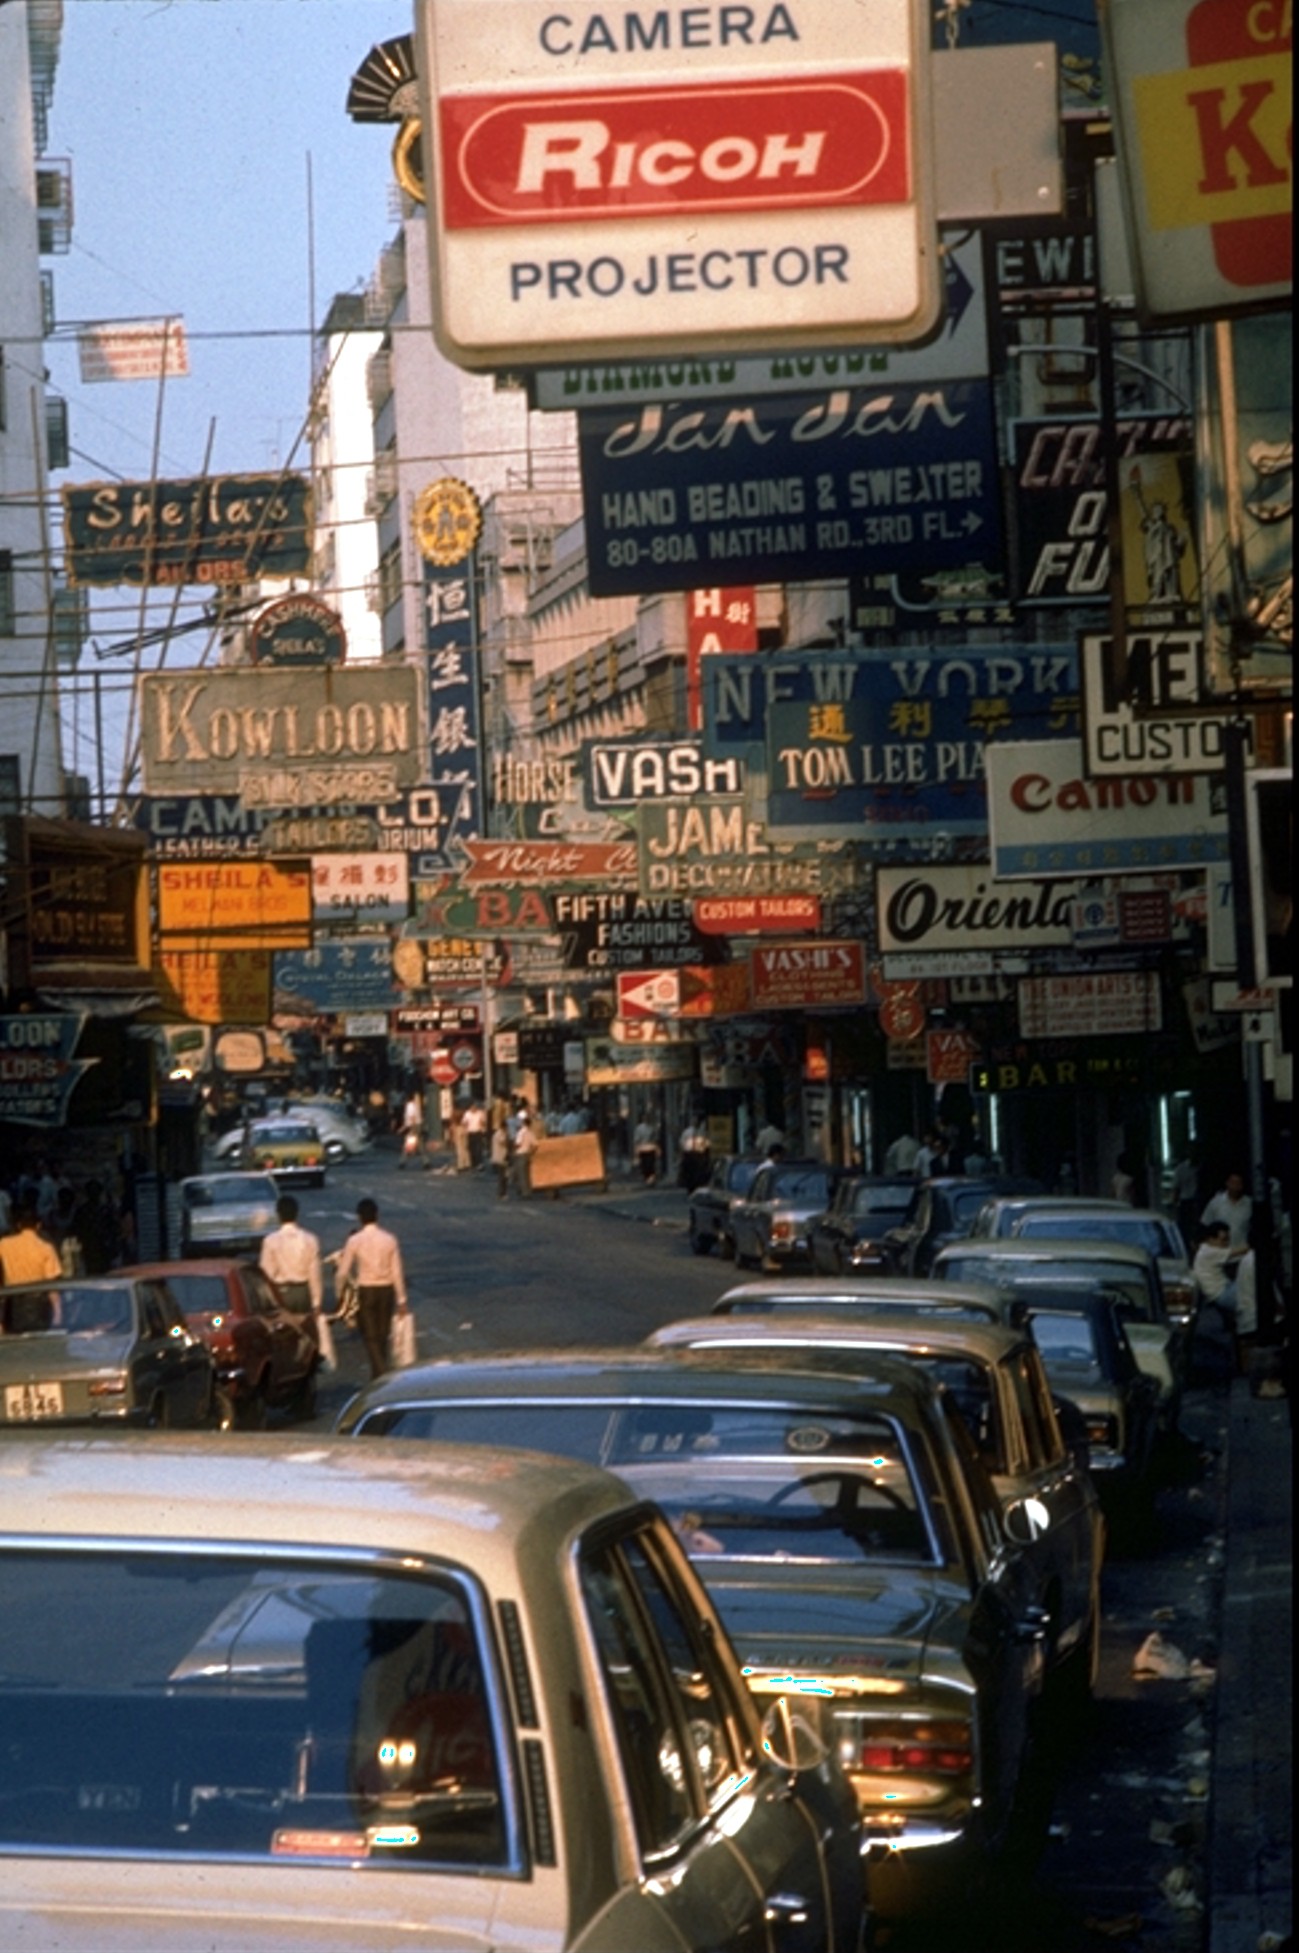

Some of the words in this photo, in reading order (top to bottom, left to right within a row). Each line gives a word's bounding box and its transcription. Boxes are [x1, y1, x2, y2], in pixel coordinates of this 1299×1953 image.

[539, 3, 800, 56] CAMERA
[514, 119, 827, 194] RICOH
[509, 243, 850, 302] PROJECTOR
[86, 479, 290, 528] Sheila's
[602, 489, 675, 530] HAND
[688, 477, 804, 522] BEADING
[816, 473, 837, 510] &
[606, 535, 698, 569] 80-80A
[709, 523, 806, 557] NATHAN
[149, 681, 412, 763] KOWLOON
[778, 745, 855, 789] TOM
[862, 741, 929, 784] LEE
[1009, 772, 1195, 814] Canon
[330, 894, 390, 910] SALON
[556, 894, 626, 922] FIFTH
[700, 902, 756, 921] CUSTOM
[761, 899, 814, 917] TAILORS
[597, 920, 691, 947] FASHIONS
[587, 949, 644, 966] CUSTOM
[760, 949, 852, 972] VASHI'S
[1000, 1062, 1077, 1090] BAR
